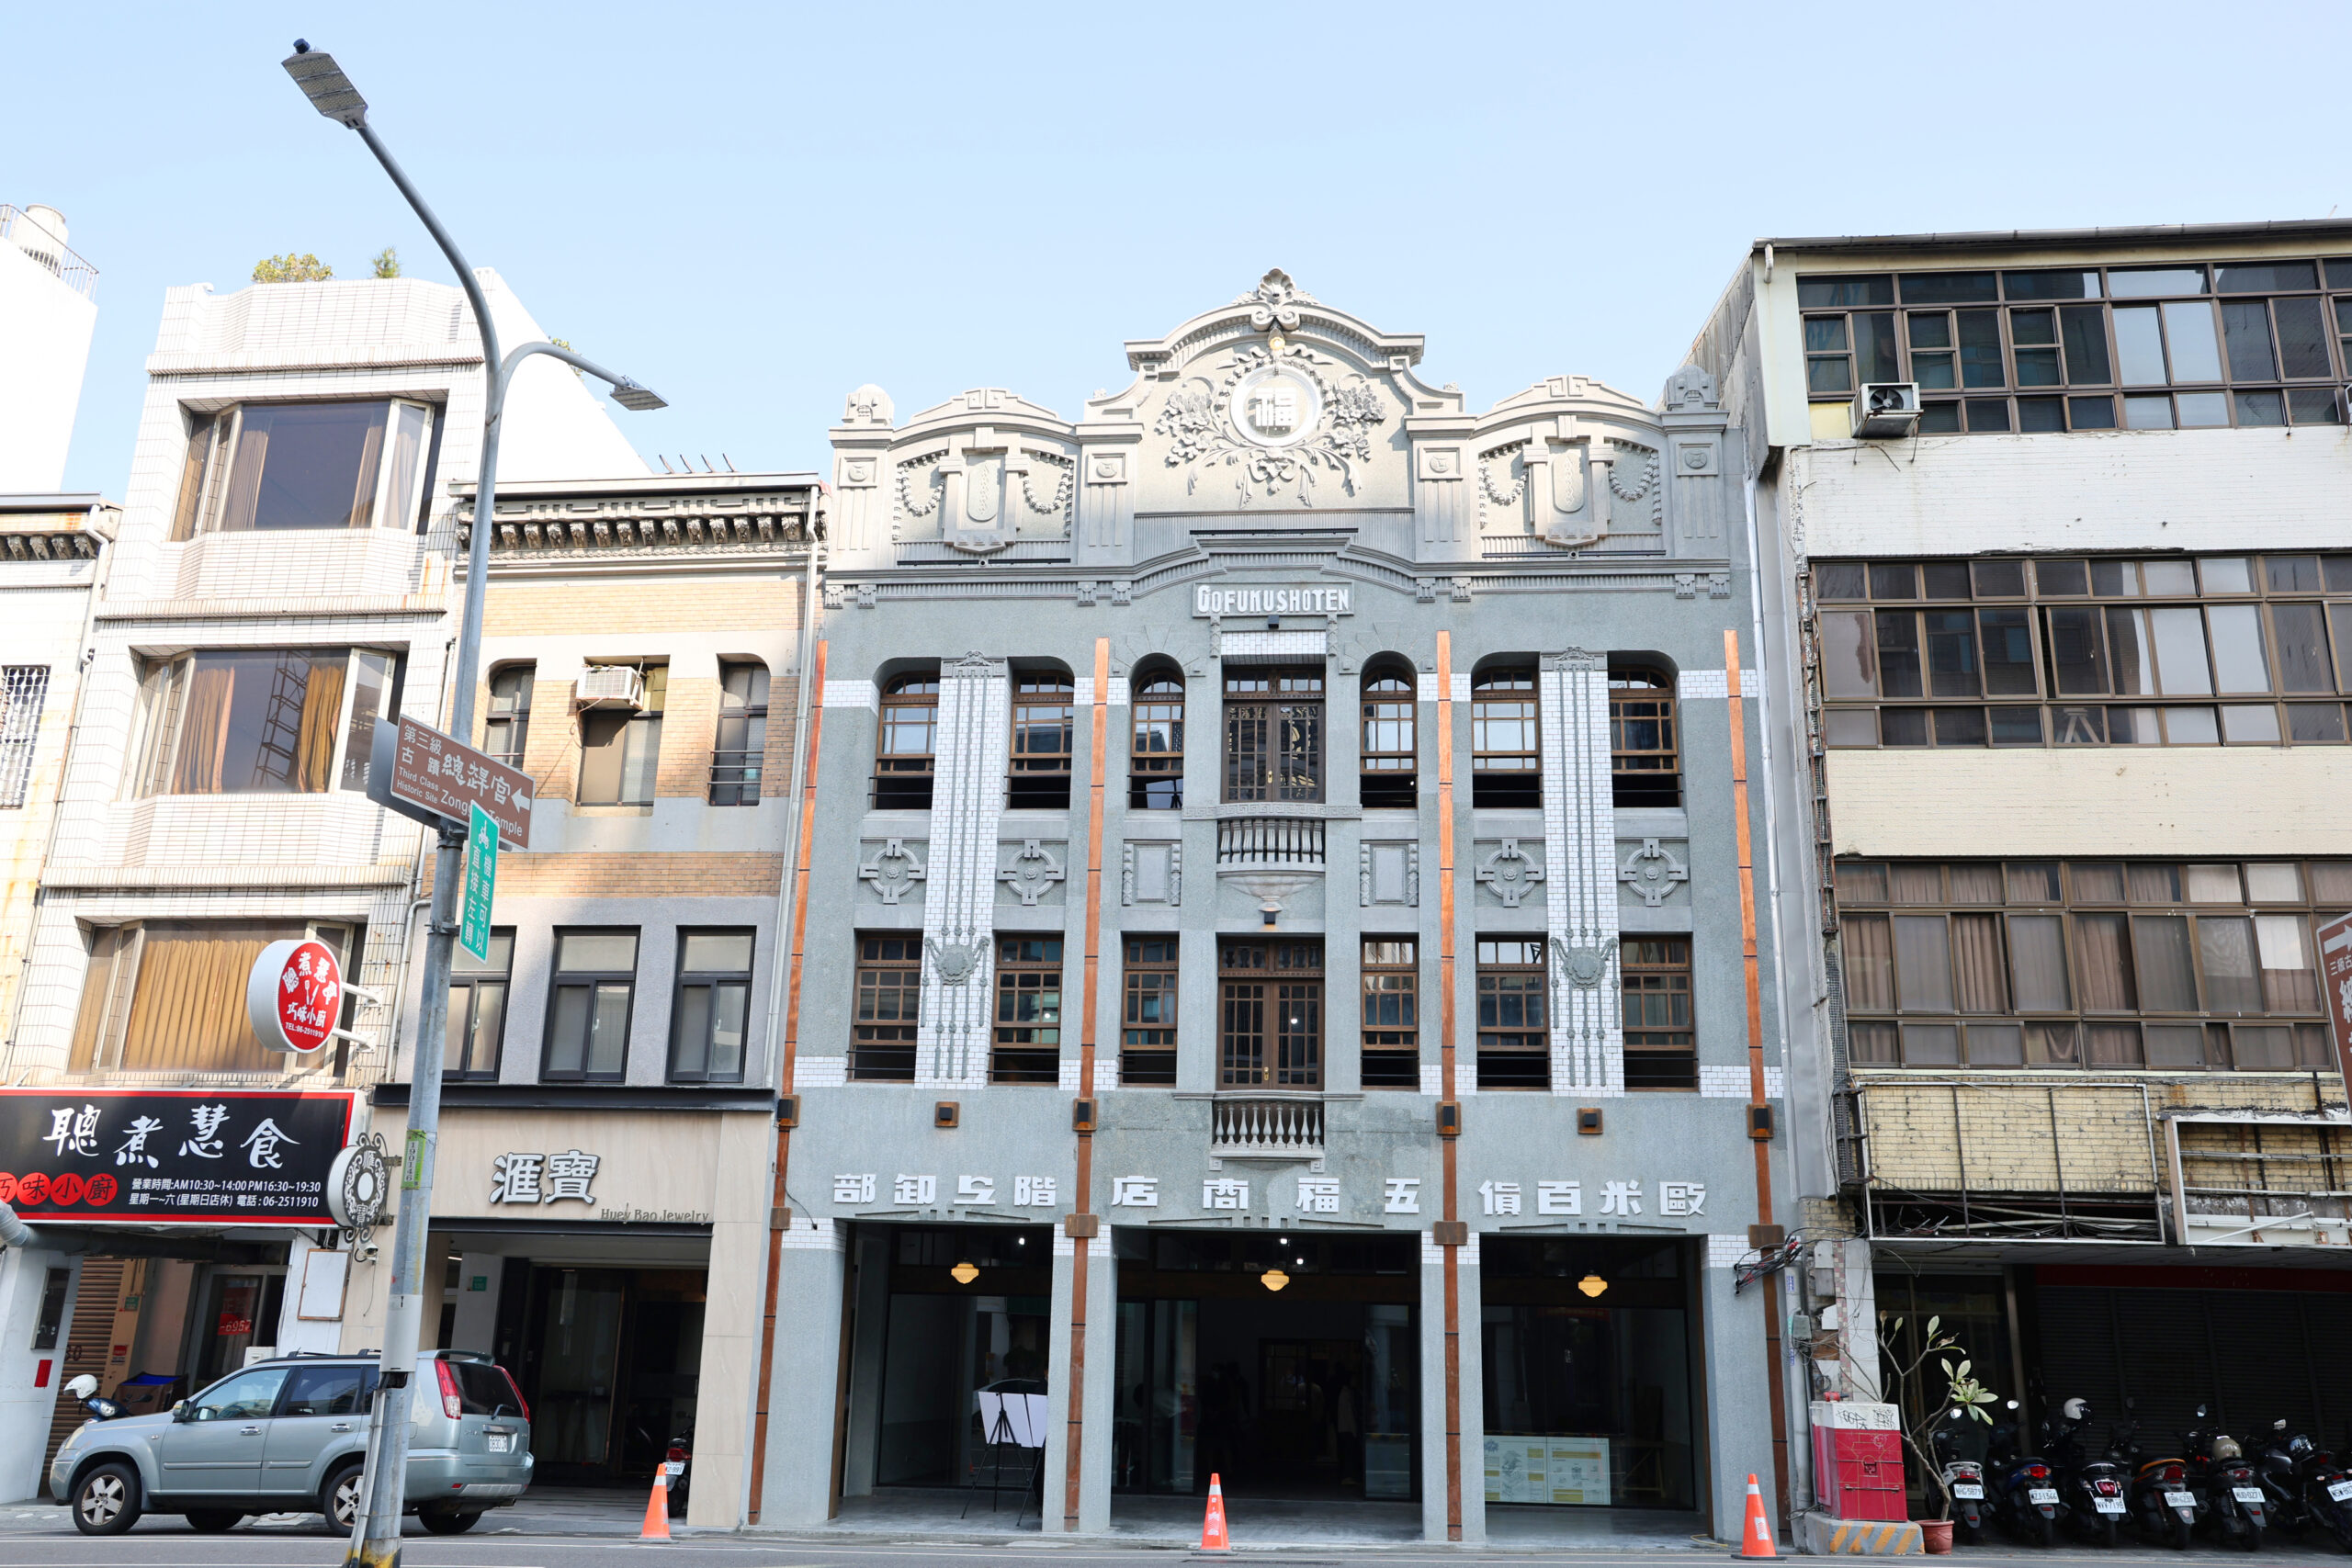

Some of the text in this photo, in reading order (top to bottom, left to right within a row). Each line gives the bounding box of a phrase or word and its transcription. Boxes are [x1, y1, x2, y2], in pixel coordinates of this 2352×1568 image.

[1197, 585, 1349, 613] GOFUKUSHOTEN
[404, 724, 441, 756] 第三級
[401, 746, 440, 778] 古蹟
[396, 779, 438, 805] Historic Site
[398, 766, 439, 792] Third Class
[464, 844, 481, 946] 直接左轉
[286, 1001, 327, 1028] 巧味小廚
[263, 1196, 319, 1208] 06-2511910
[635, 1209, 658, 1222] Bao
[660, 1210, 709, 1223] Jewelry
